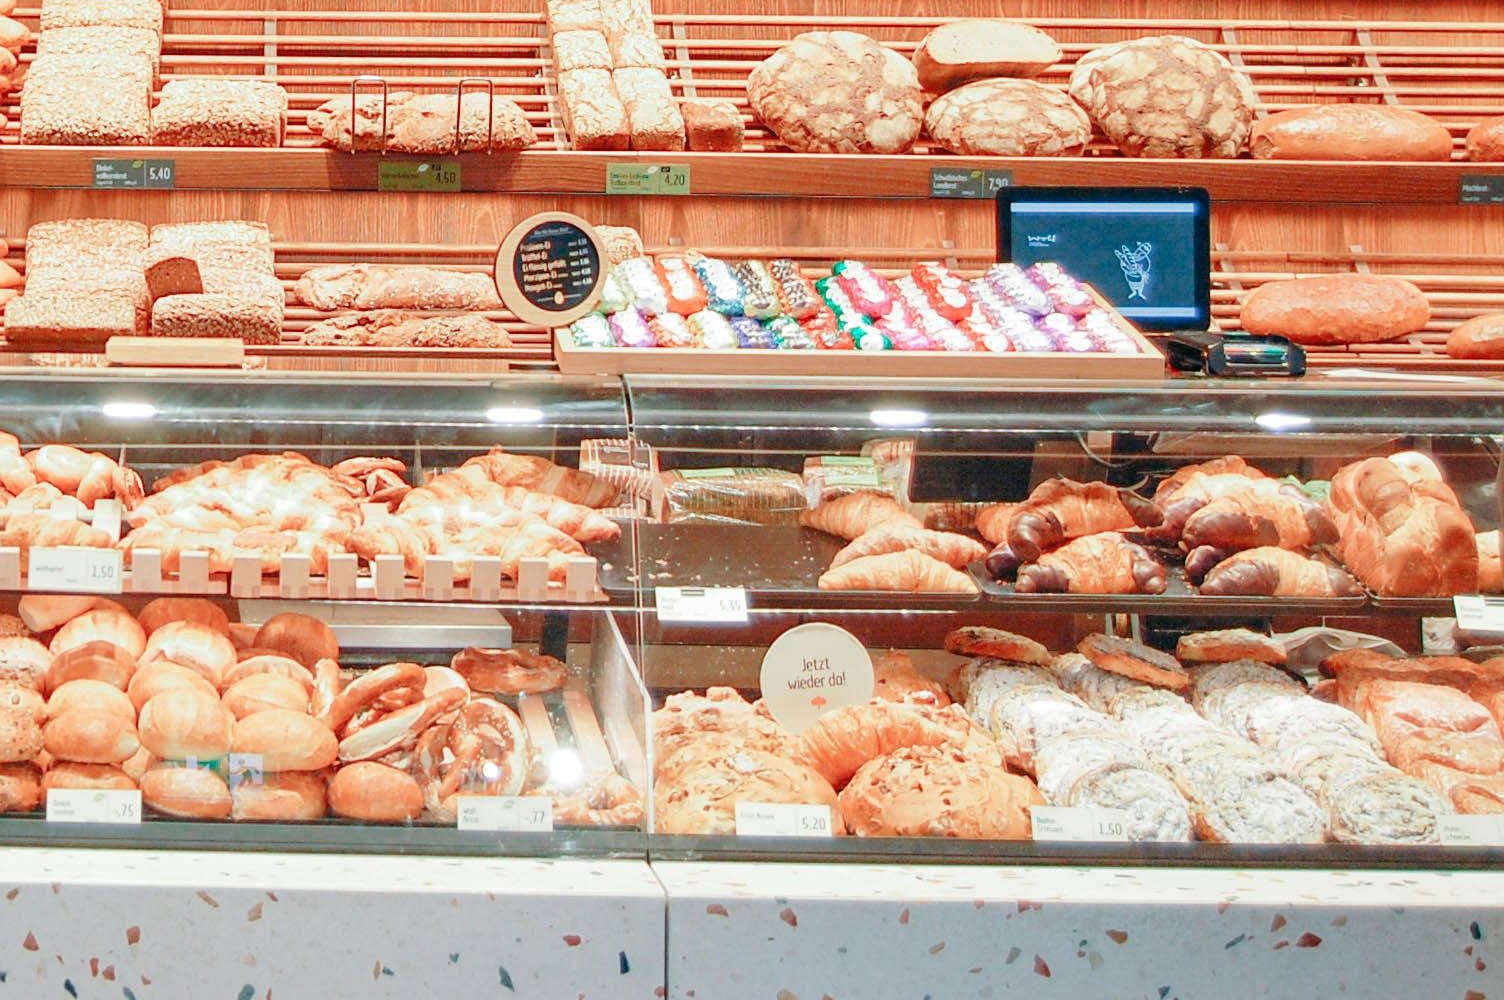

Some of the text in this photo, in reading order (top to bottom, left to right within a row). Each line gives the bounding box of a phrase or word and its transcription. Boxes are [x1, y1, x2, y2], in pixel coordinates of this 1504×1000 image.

[802, 657, 830, 672] Jetzt
[787, 671, 846, 690] wieder da!
